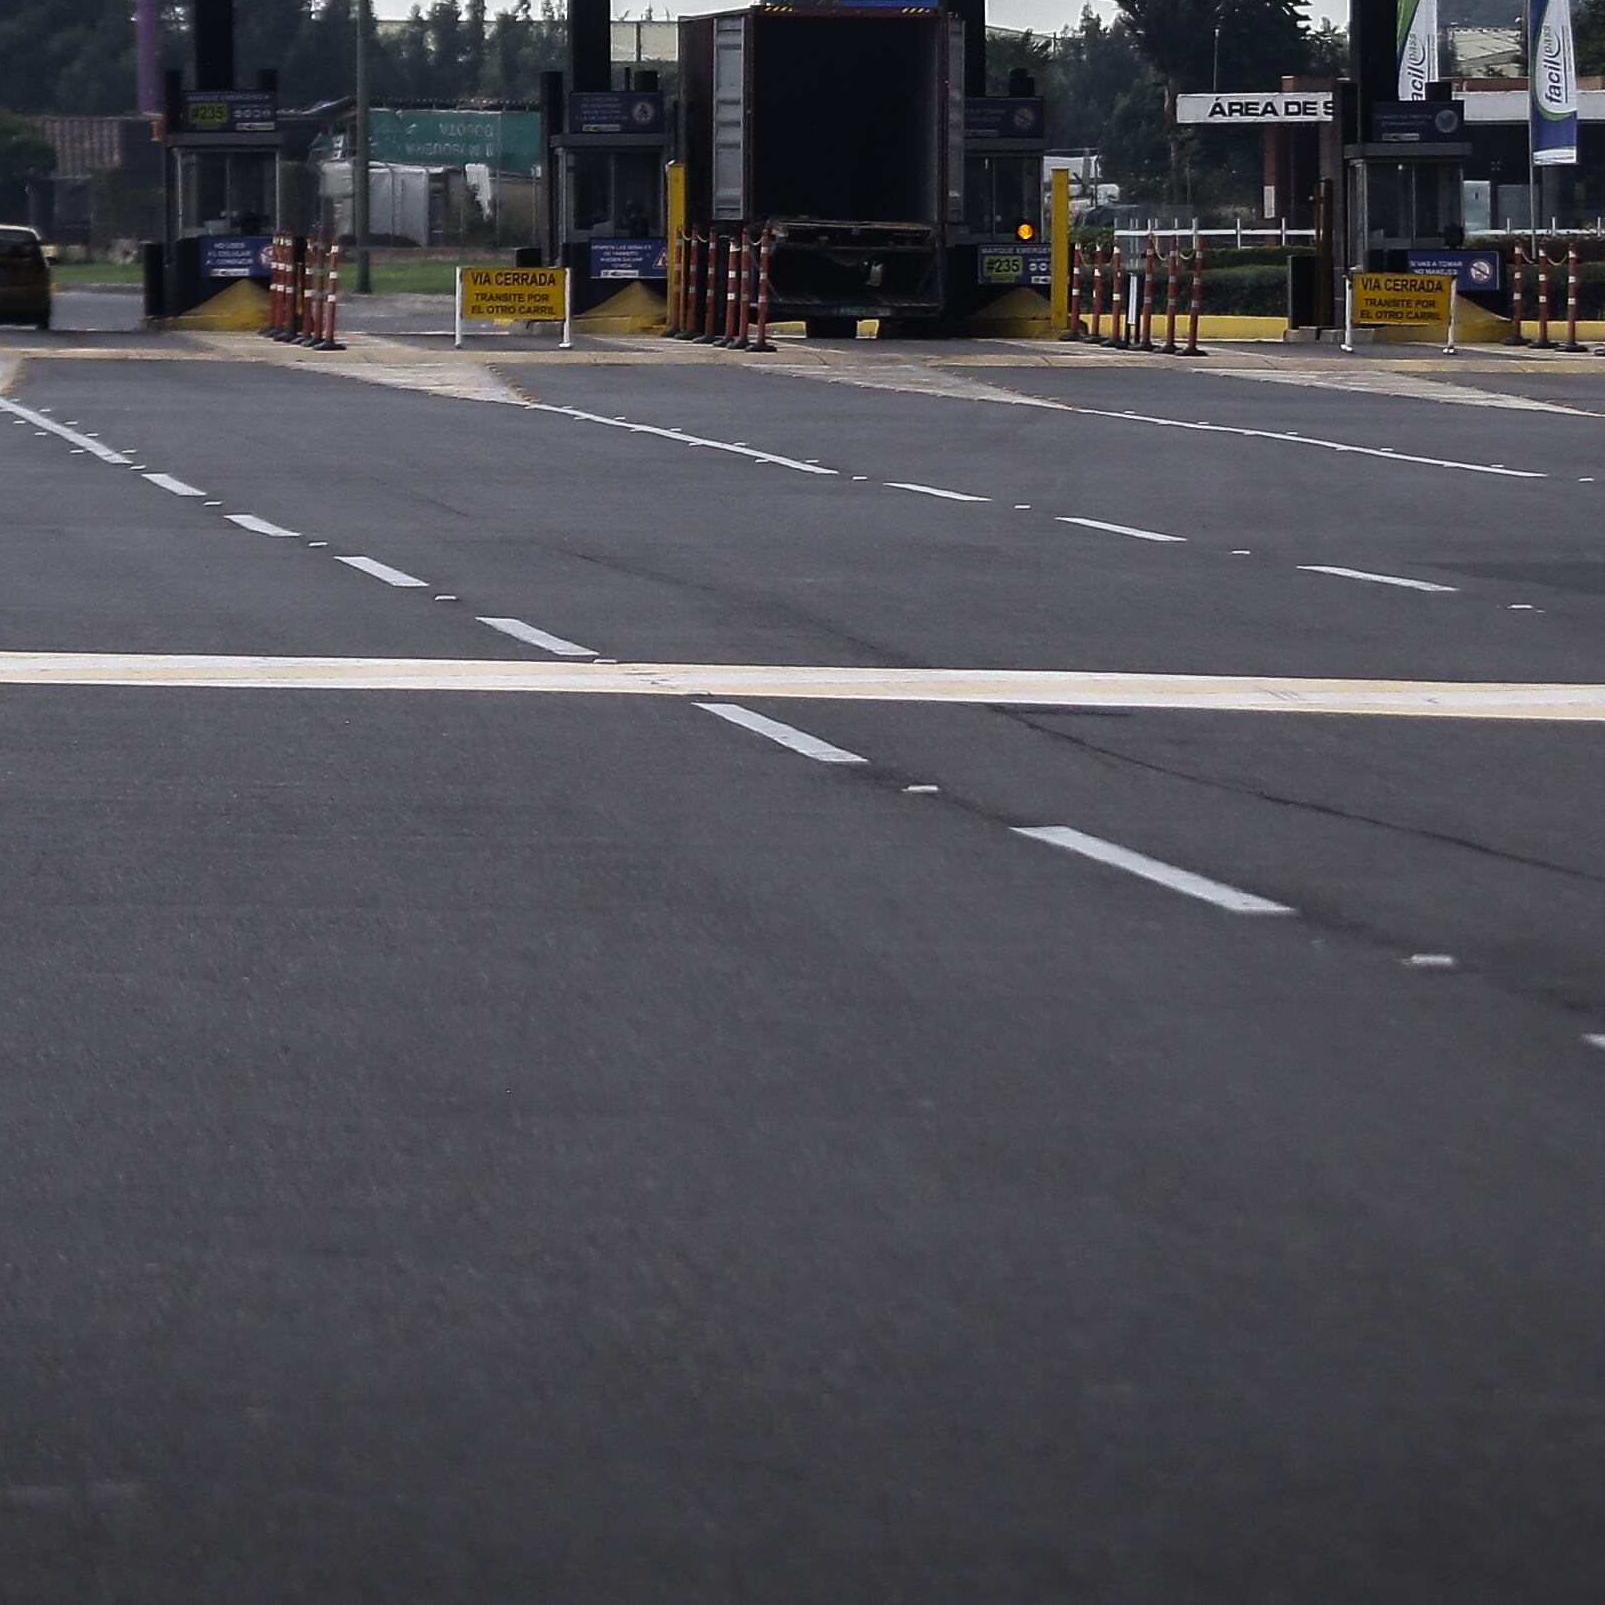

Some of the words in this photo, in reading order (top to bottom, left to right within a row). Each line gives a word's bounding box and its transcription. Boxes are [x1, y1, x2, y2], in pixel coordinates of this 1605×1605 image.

[1543, 25, 1553, 54] pass
[1408, 66, 1424, 101] acil
[1543, 58, 1562, 103] facil
[191, 106, 223, 120] #235
[1208, 97, 1279, 117] ÁREA
[1284, 101, 1318, 116] DE
[986, 259, 1020, 273] #235
[471, 273, 492, 286] VIA
[495, 273, 556, 286] CERRADA
[1361, 278, 1380, 291] VIA
[1385, 278, 1443, 293] CERRADA
[475, 293, 525, 302] TRANSITE
[527, 294, 549, 302] POR
[1364, 298, 1412, 308] TRANSITE
[1415, 299, 1435, 308] POR
[471, 306, 484, 314] EL
[486, 306, 516, 314] OTRO
[518, 306, 555, 315] CARRIL
[1360, 310, 1372, 318] EL
[1375, 310, 1403, 319] OTRO
[1406, 310, 1441, 320] CARRIL
